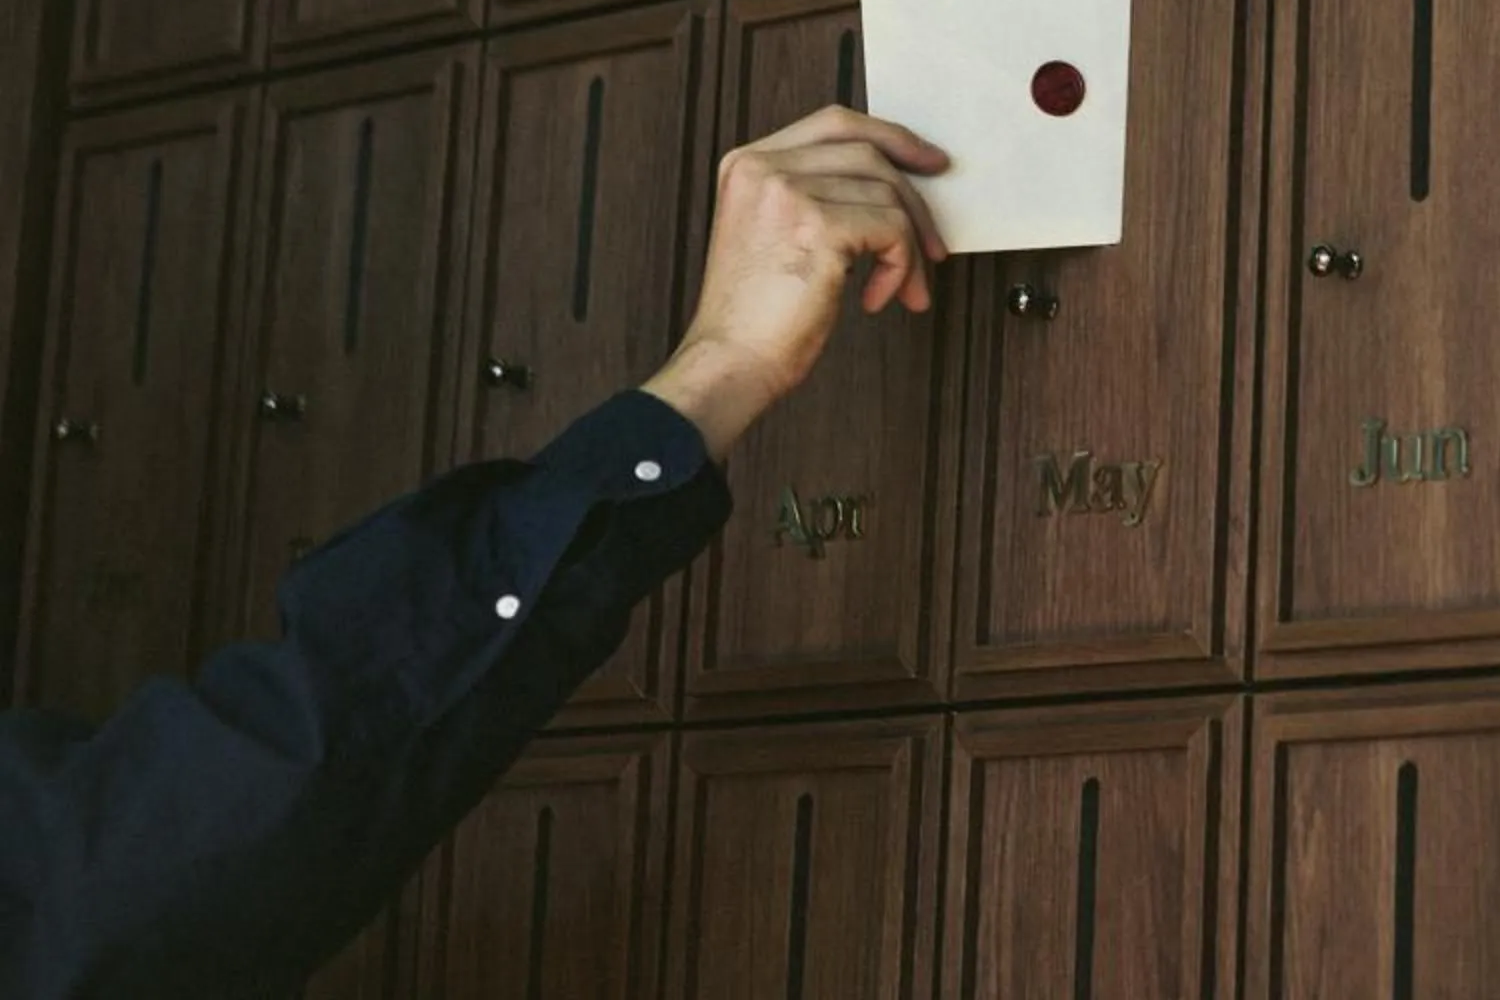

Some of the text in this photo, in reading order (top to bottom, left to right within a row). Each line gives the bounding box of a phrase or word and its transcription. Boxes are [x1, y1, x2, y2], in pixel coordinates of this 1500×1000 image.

[1032, 449, 1168, 527] May
[1350, 417, 1471, 487] Jun
[771, 481, 873, 560] Apr
